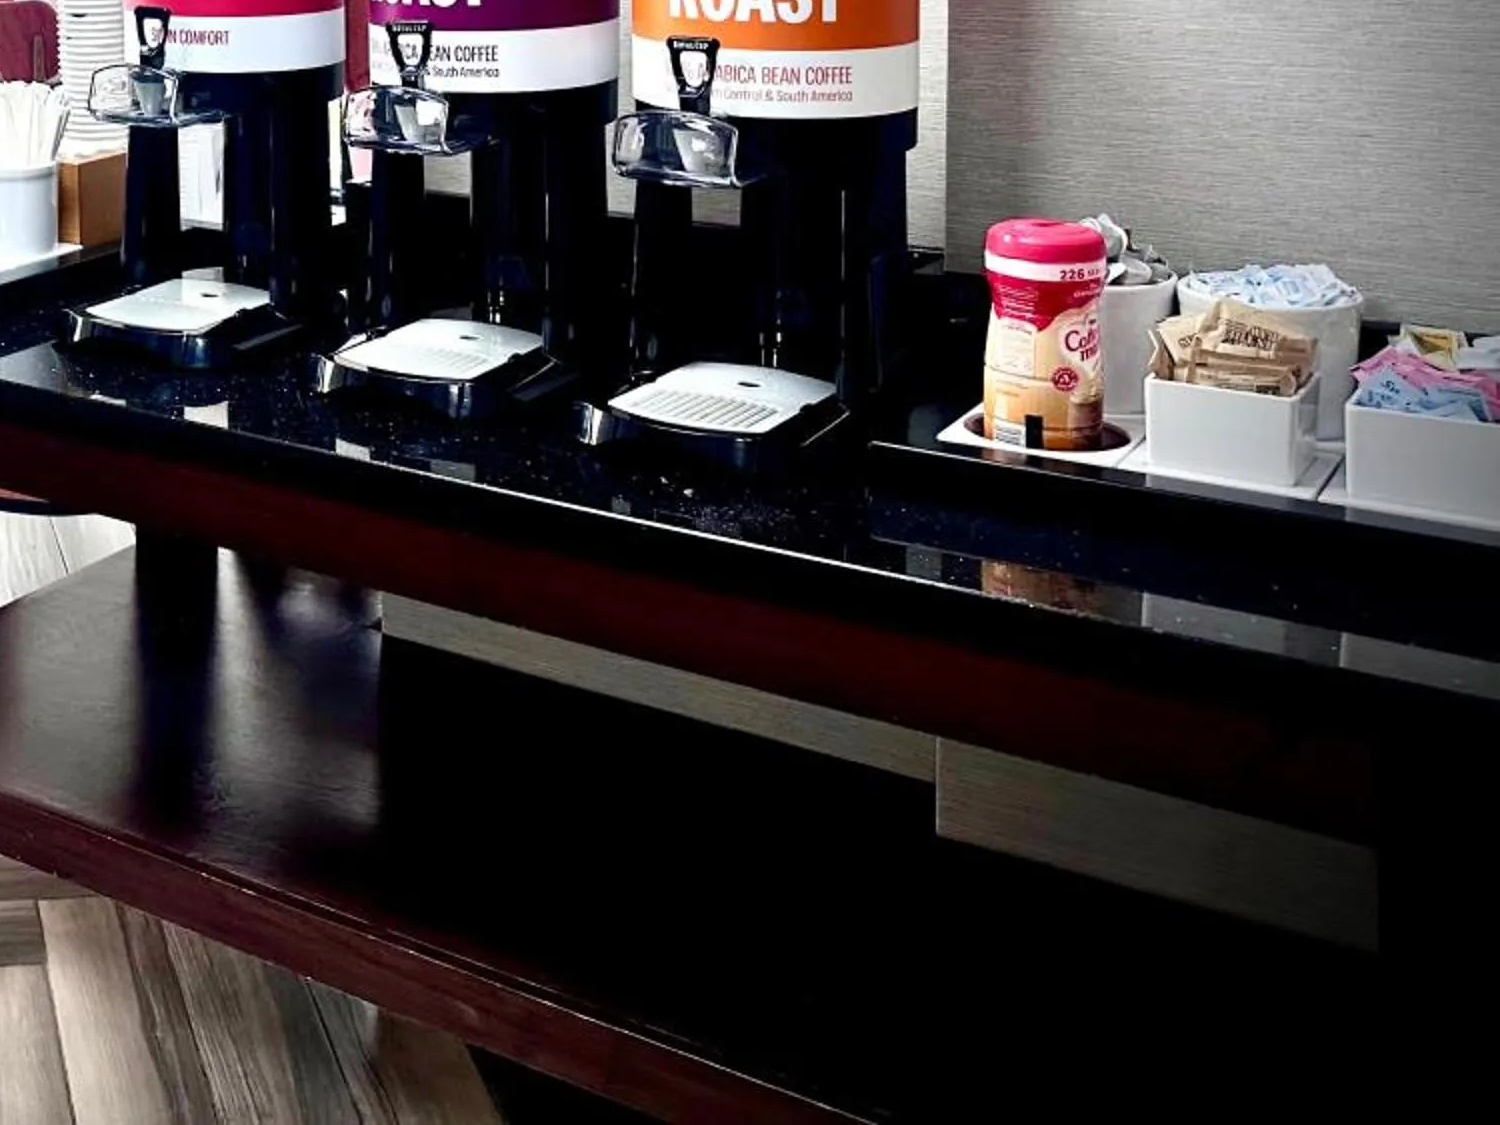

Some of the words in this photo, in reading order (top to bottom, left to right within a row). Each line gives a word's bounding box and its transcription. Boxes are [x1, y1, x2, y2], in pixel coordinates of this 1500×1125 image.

[180, 29, 229, 45] COMFORT
[429, 44, 451, 62] EAN
[454, 44, 499, 62] COFFEE
[432, 66, 459, 78] South
[461, 66, 500, 78] America
[697, 63, 756, 84] AABICA
[761, 66, 801, 85] BEAN
[805, 66, 853, 85] COFFEE
[764, 89, 774, 102] &
[776, 90, 809, 102] South
[810, 90, 853, 102] America
[1060, 268, 1085, 280] 226
